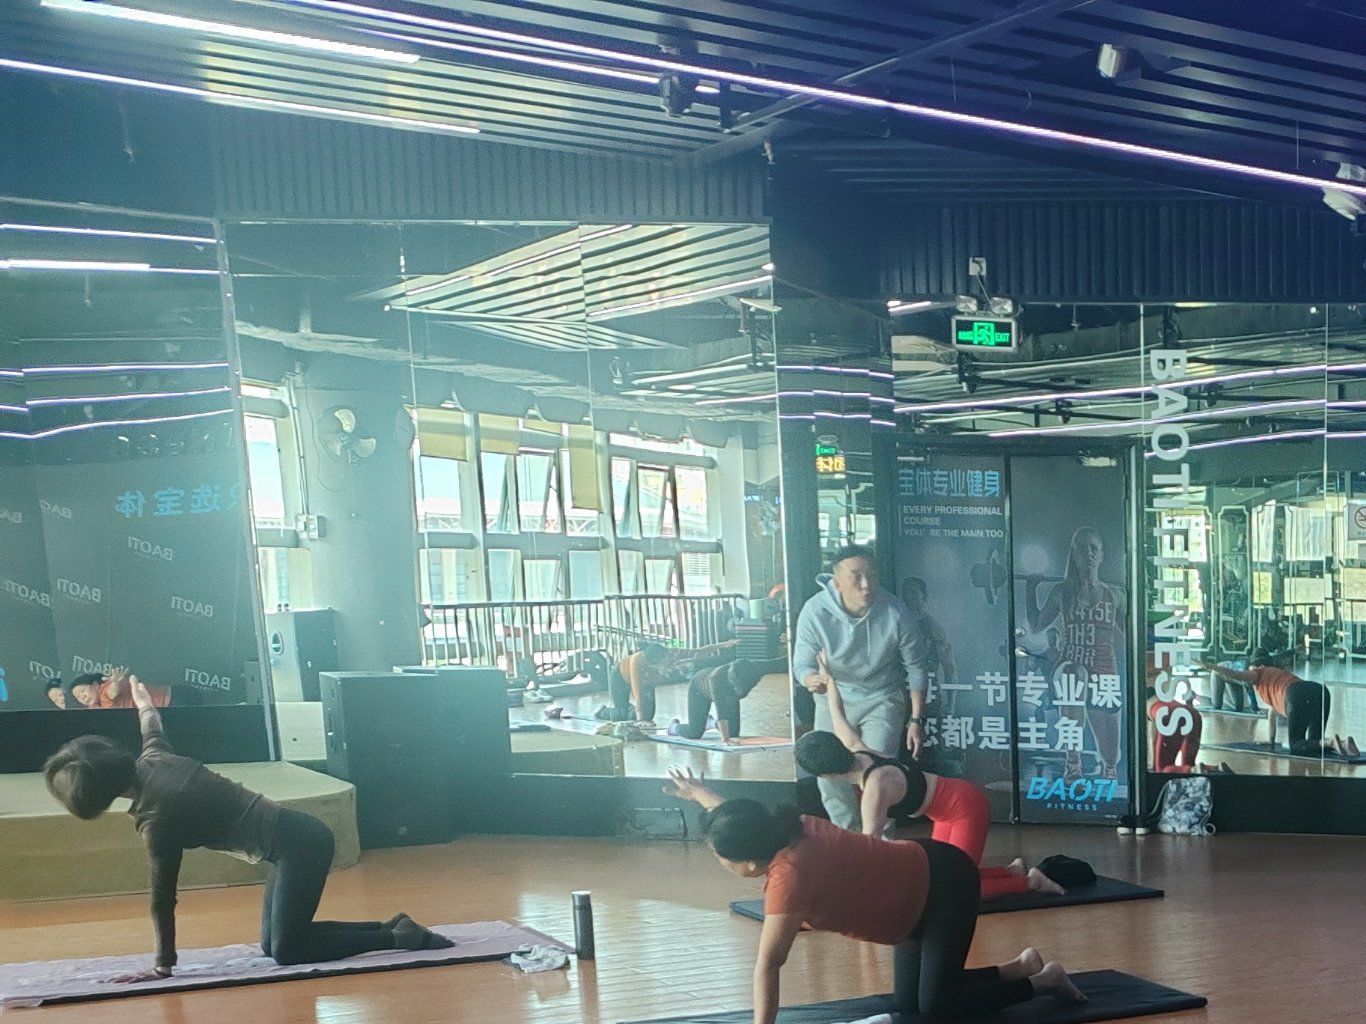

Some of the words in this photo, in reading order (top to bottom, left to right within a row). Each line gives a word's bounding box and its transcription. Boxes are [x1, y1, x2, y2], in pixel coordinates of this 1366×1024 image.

[898, 468, 1000, 497] 宝体专业健身
[903, 505, 932, 514] EVERY
[934, 506, 1002, 516] PROFESSIONAL
[903, 517, 940, 526] COURSE
[943, 529, 959, 537] THE
[961, 529, 983, 537] MAIN
[1026, 777, 1118, 801] BAOTI
[1046, 803, 1097, 811] FITNESS
